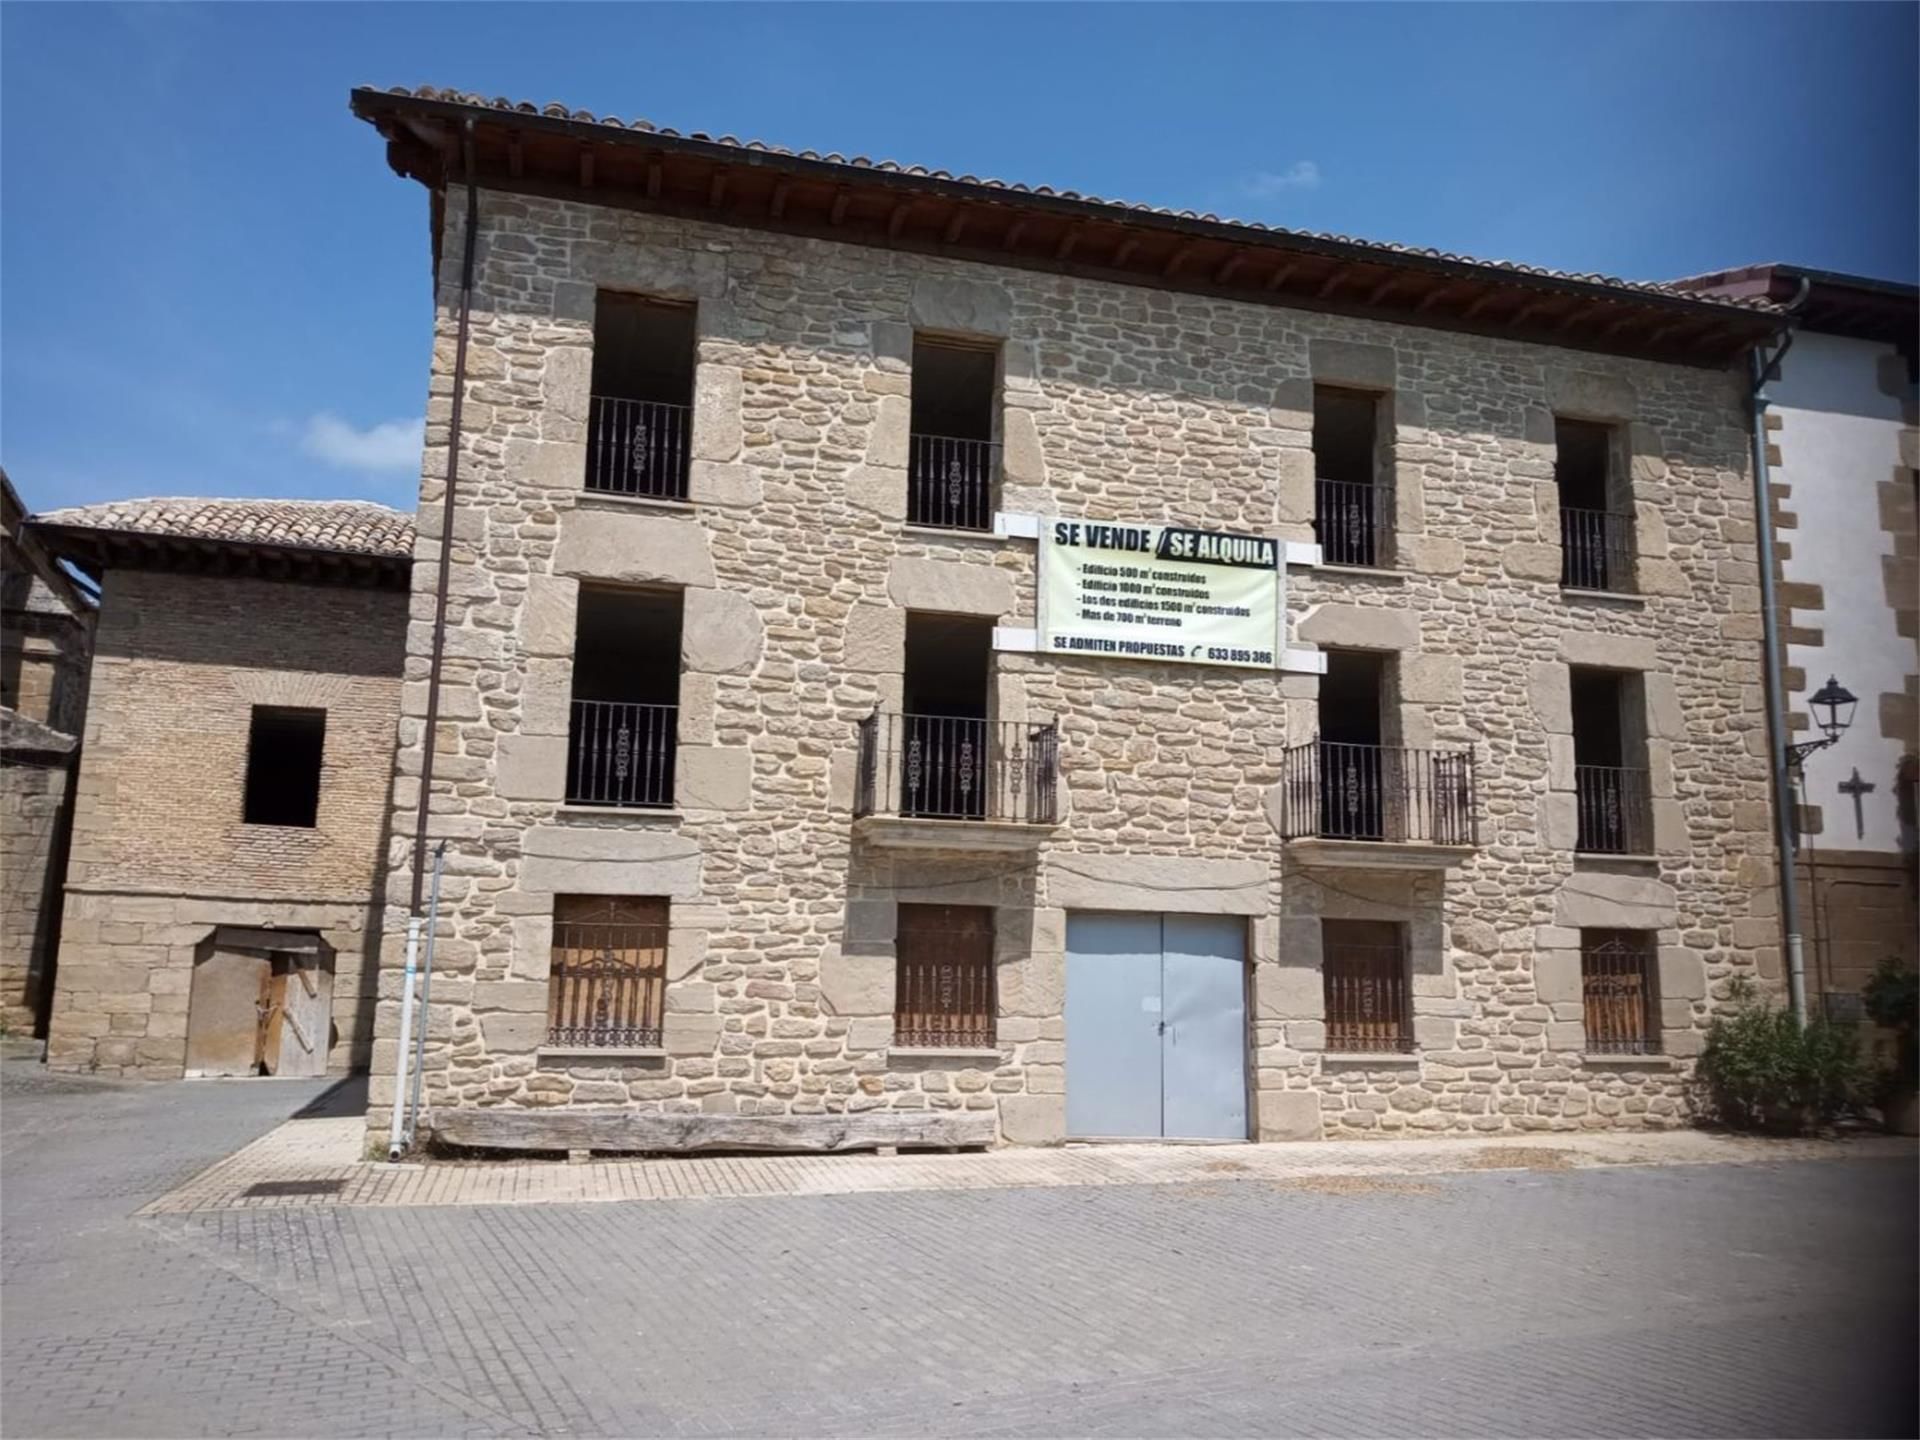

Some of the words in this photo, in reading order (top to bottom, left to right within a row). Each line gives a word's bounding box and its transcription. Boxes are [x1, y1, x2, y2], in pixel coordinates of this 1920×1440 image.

[1055, 522, 1080, 546] SE
[1085, 524, 1150, 552] VENDE
[1170, 532, 1195, 557] SE
[1197, 534, 1274, 565] ALQUILA
[1082, 563, 1118, 576] Edificio
[1119, 566, 1138, 578] 500
[1152, 571, 1206, 584] construidos
[1082, 579, 1117, 592] Edificio
[1099, 595, 1116, 607] dos
[1103, 611, 1115, 621] de
[1147, 615, 1182, 627] terreno
[1054, 636, 1067, 648] SE
[1069, 637, 1116, 652] ADMITEN
[1119, 641, 1185, 657] PROPUESTAS
[1208, 647, 1228, 660] 633
